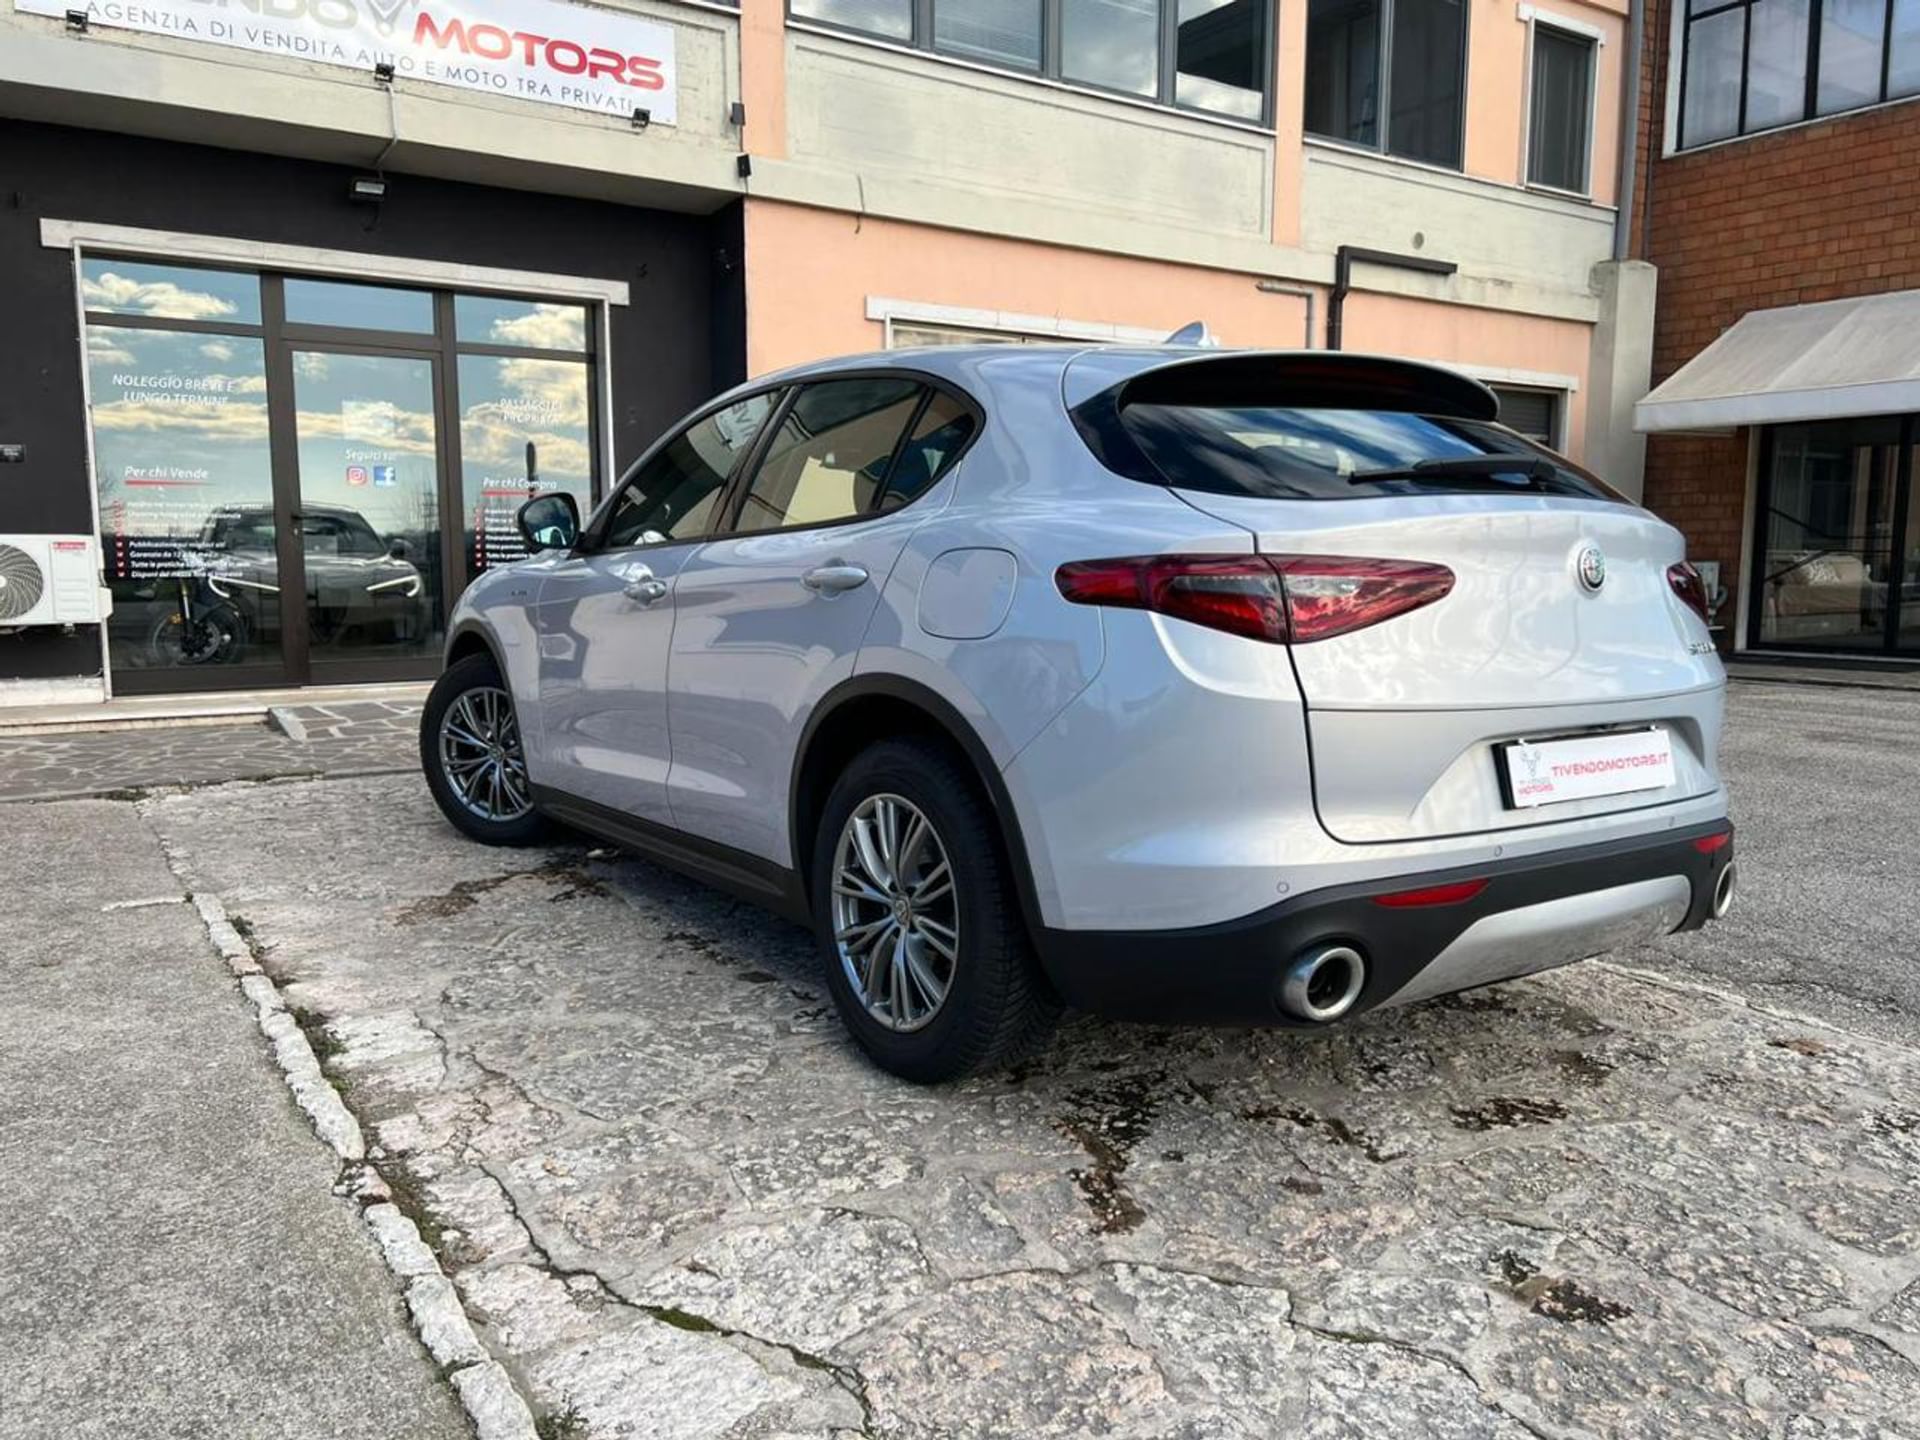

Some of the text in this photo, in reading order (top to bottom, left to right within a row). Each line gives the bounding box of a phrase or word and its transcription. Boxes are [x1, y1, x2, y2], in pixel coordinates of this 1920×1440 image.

[86, 1, 633, 112] AGENZIA DI VENDITA AUTO E MOTO TRA PRIVATI
[413, 12, 665, 91] MOTORS
[112, 373, 182, 389] NOLEGGIO
[123, 391, 170, 403] LUNGO
[124, 465, 209, 479] Per chi Vende
[483, 476, 500, 487] Per
[517, 478, 557, 490] Compra
[1551, 753, 1669, 777] TIVENDOMOTORS.IT
